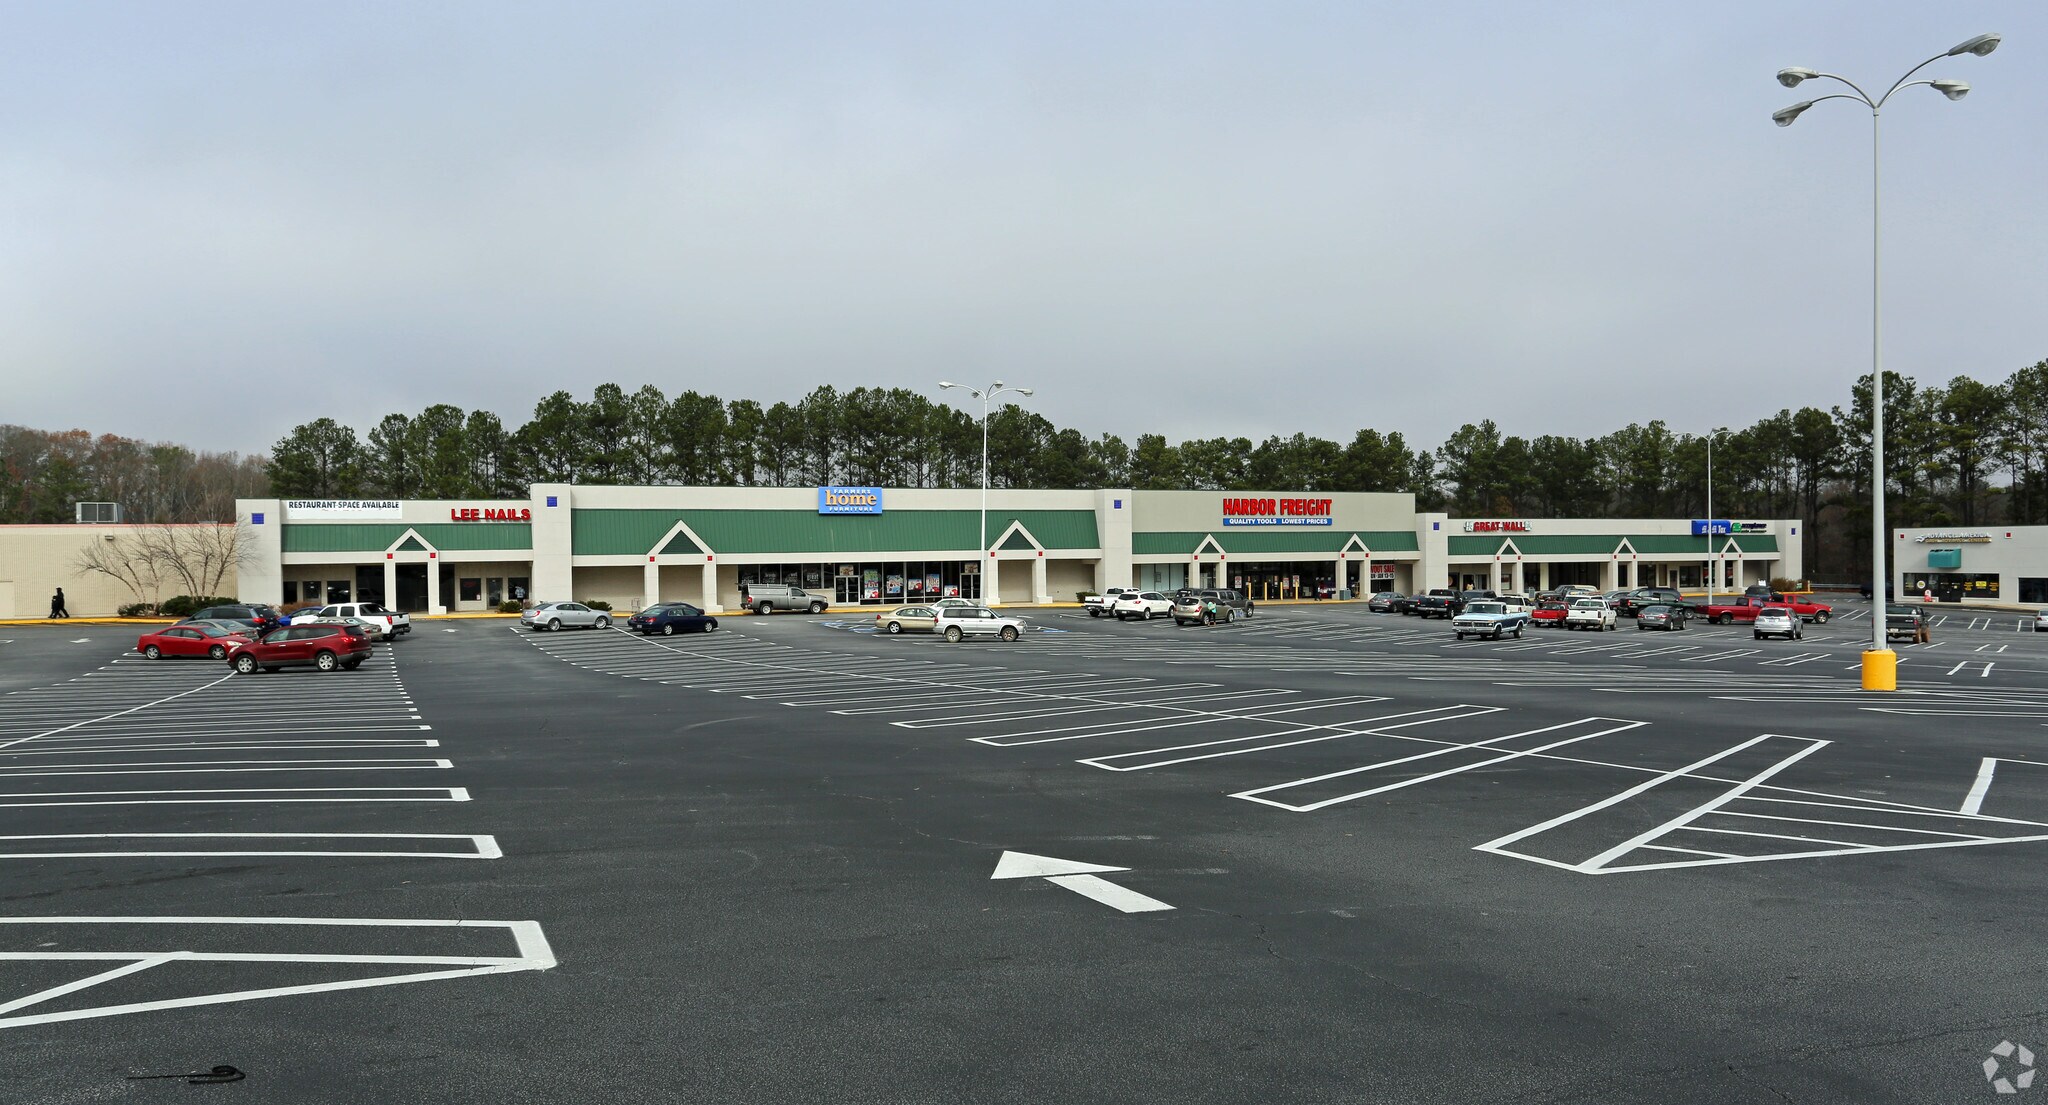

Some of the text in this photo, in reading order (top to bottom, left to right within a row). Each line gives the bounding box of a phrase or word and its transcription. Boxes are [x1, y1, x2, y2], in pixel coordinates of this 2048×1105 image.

[825, 489, 877, 506] home
[288, 501, 400, 509] RESTAURANT SPACE AVAILABLE
[1223, 498, 1332, 516] HARBOR FREIGHT
[451, 508, 531, 521] LEE NAILS
[1473, 521, 1500, 532] GREAT
[1503, 521, 1526, 532] WALL
